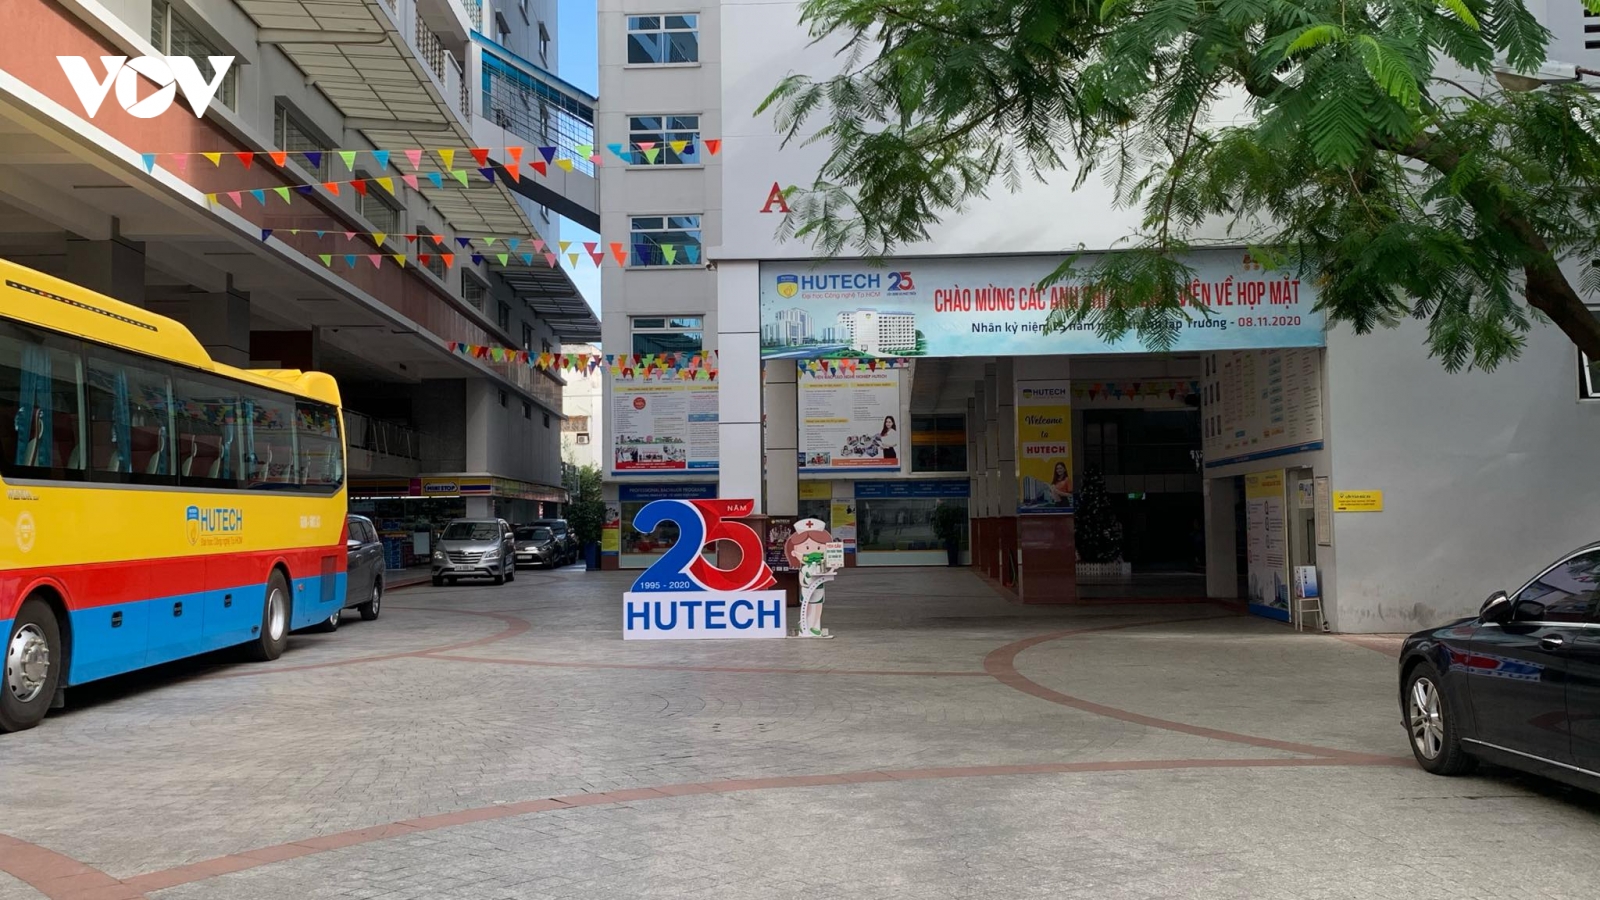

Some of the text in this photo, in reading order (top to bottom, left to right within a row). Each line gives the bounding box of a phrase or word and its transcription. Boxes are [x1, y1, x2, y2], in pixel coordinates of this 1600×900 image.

[760, 182, 792, 213] A
[802, 274, 880, 290] HUTECH
[887, 272, 915, 291] 25
[934, 284, 971, 312] CHÀO
[975, 283, 1015, 312] MỪNG
[1019, 283, 1046, 311] CÁC
[1215, 275, 1234, 306] VỀ
[1237, 281, 1266, 310] HỌP
[1269, 274, 1301, 310] MẶT
[971, 322, 1002, 333] Nhân
[1238, 316, 1301, 327] 08.11.2020
[1032, 388, 1066, 397] HUTECH
[1024, 415, 1063, 426] Welcome
[1026, 446, 1066, 454] HUTECH
[727, 504, 747, 512] NĂM
[201, 508, 243, 532] HUTECH
[631, 499, 765, 592] 25
[669, 581, 690, 589] 2020
[627, 599, 781, 631] HUTECH
